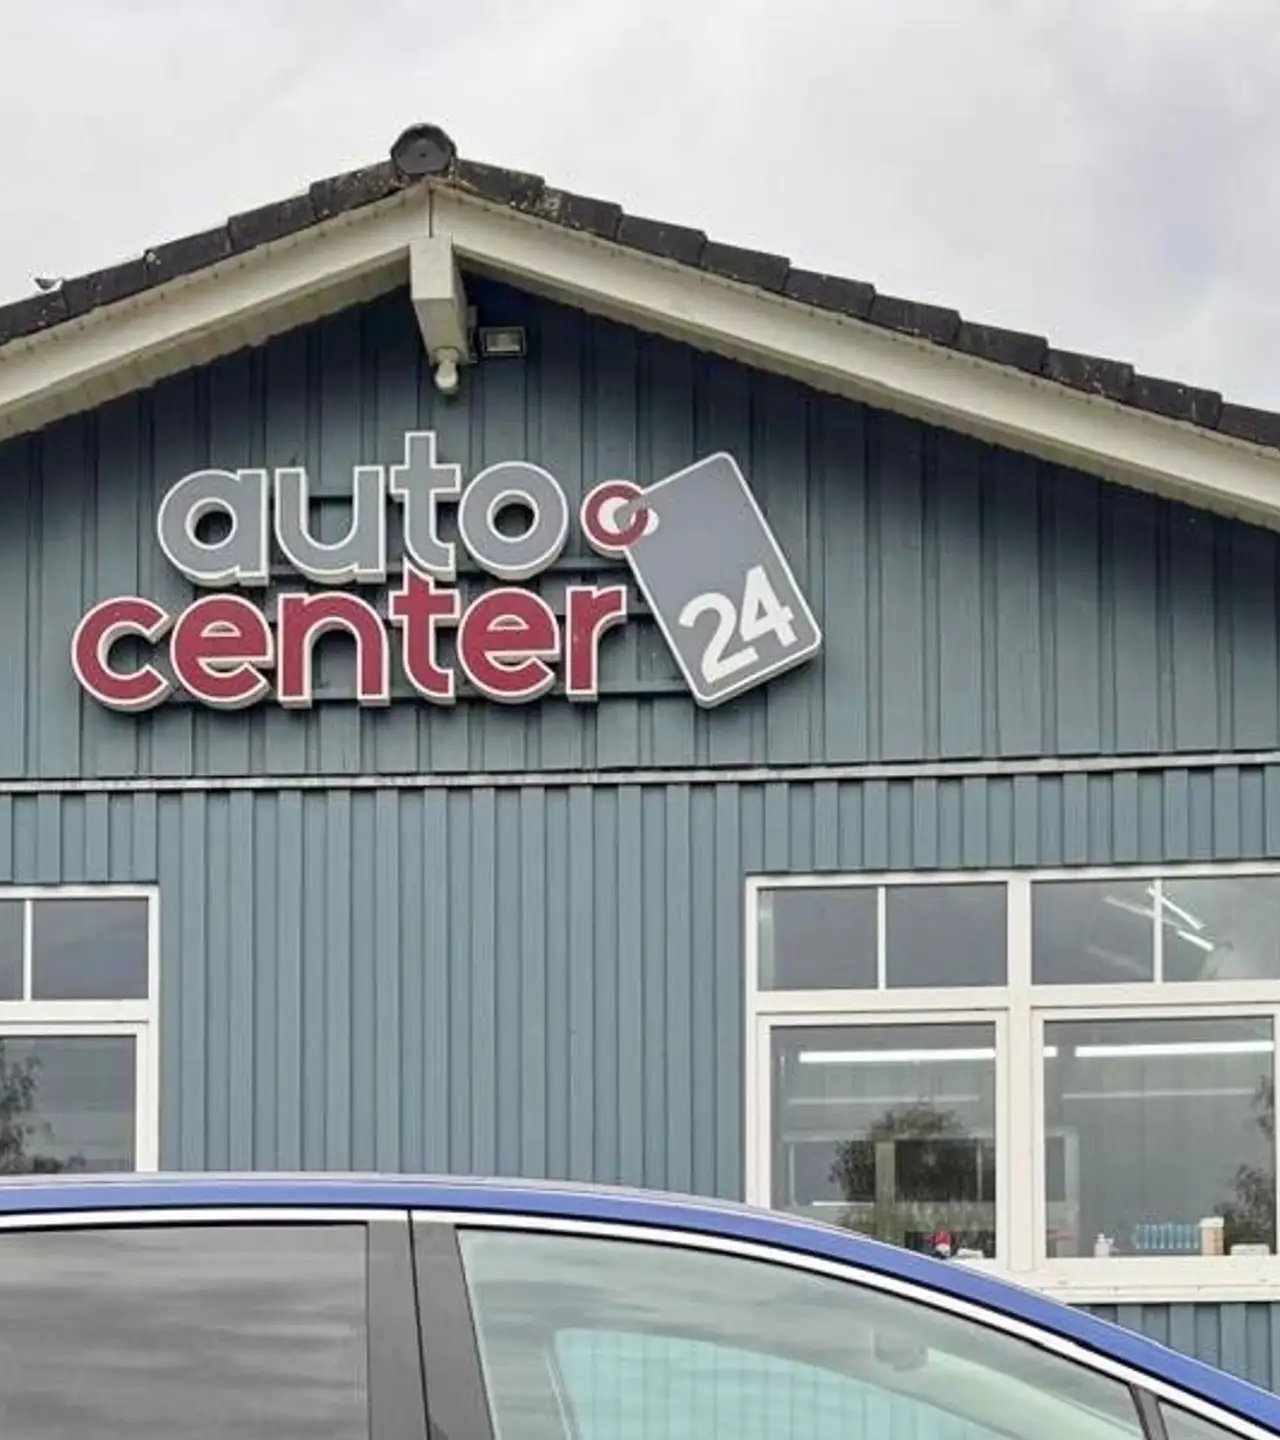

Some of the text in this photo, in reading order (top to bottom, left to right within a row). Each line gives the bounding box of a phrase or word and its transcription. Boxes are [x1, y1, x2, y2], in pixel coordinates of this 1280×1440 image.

[157, 431, 569, 586] auto
[72, 557, 627, 709] center
[677, 566, 797, 684] 24
